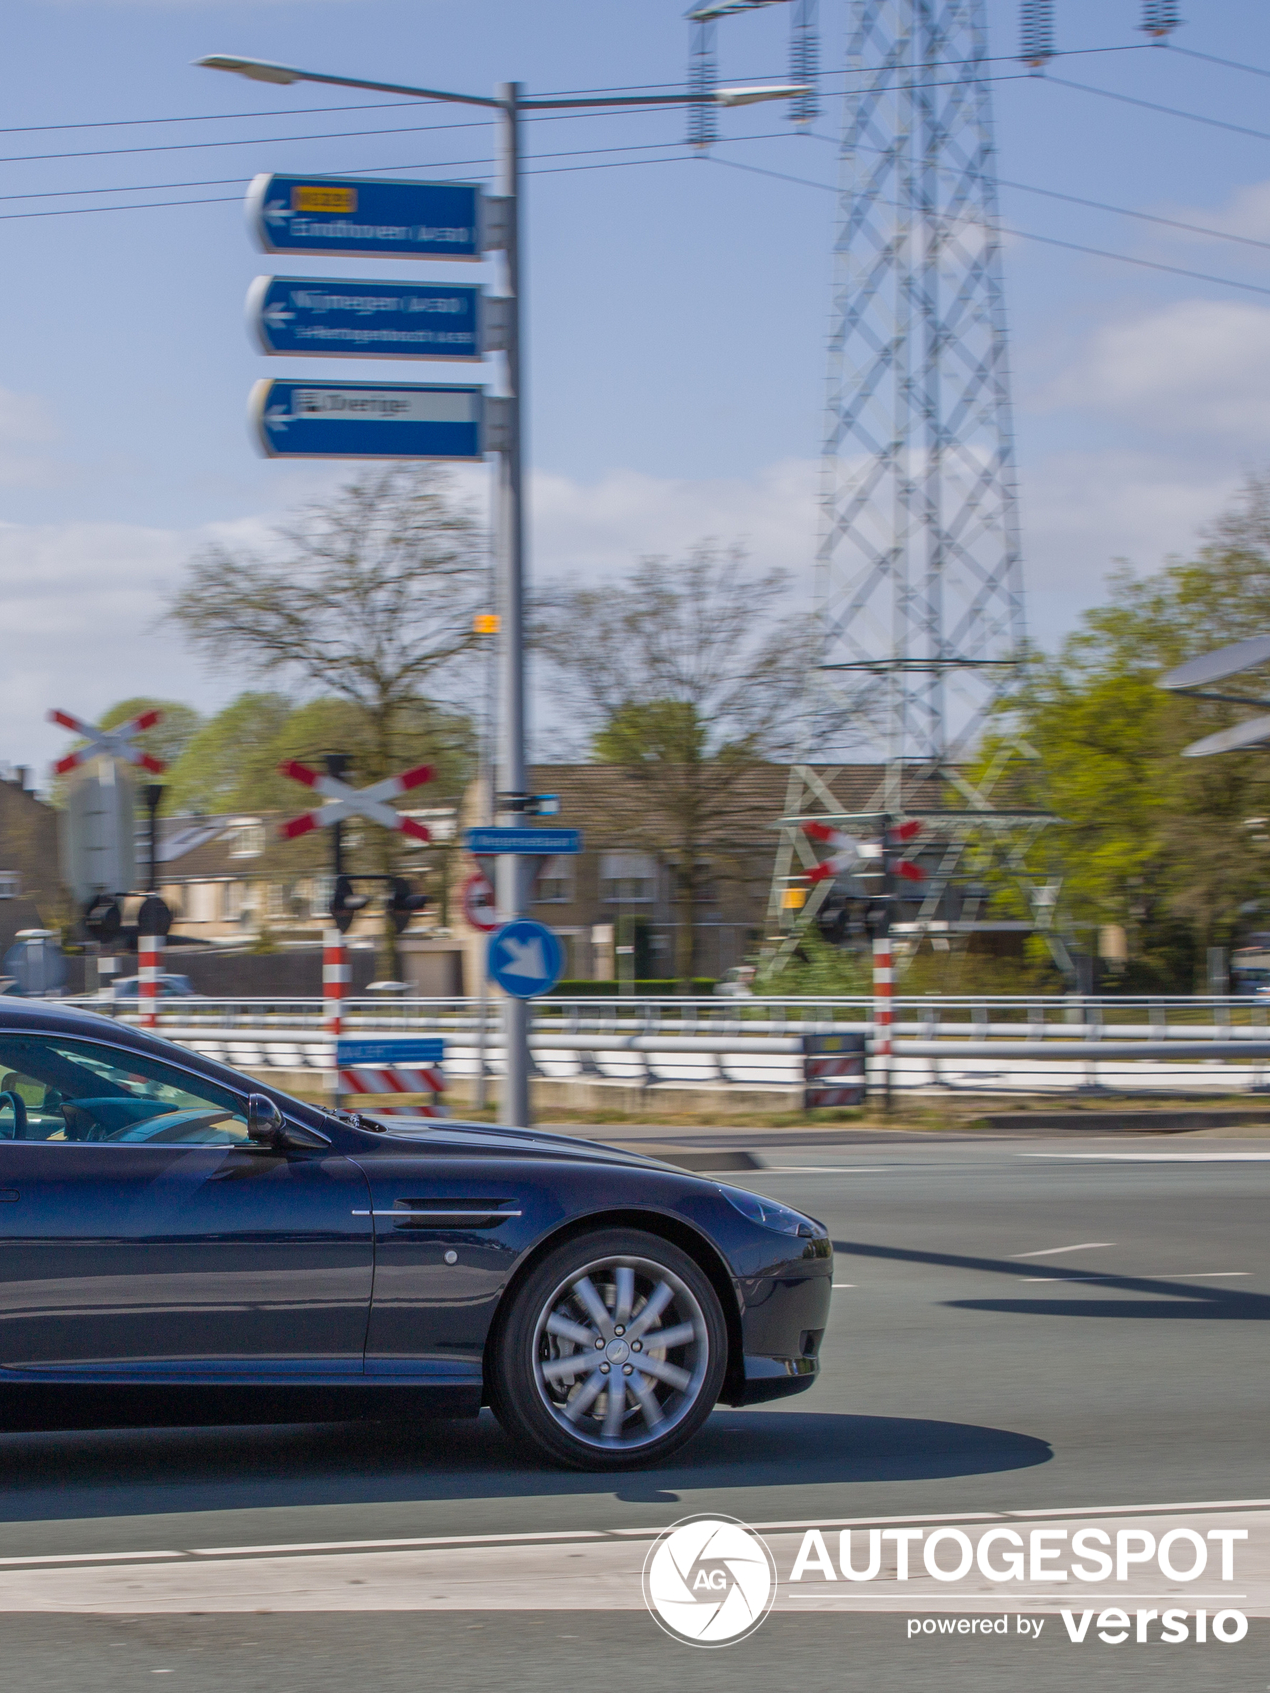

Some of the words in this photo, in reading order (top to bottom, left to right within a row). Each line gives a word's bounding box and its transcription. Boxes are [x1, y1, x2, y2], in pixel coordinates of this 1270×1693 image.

[291, 217, 409, 239] Eindhoven
[291, 290, 401, 315] Nijmegen
[325, 394, 411, 417] Overige
